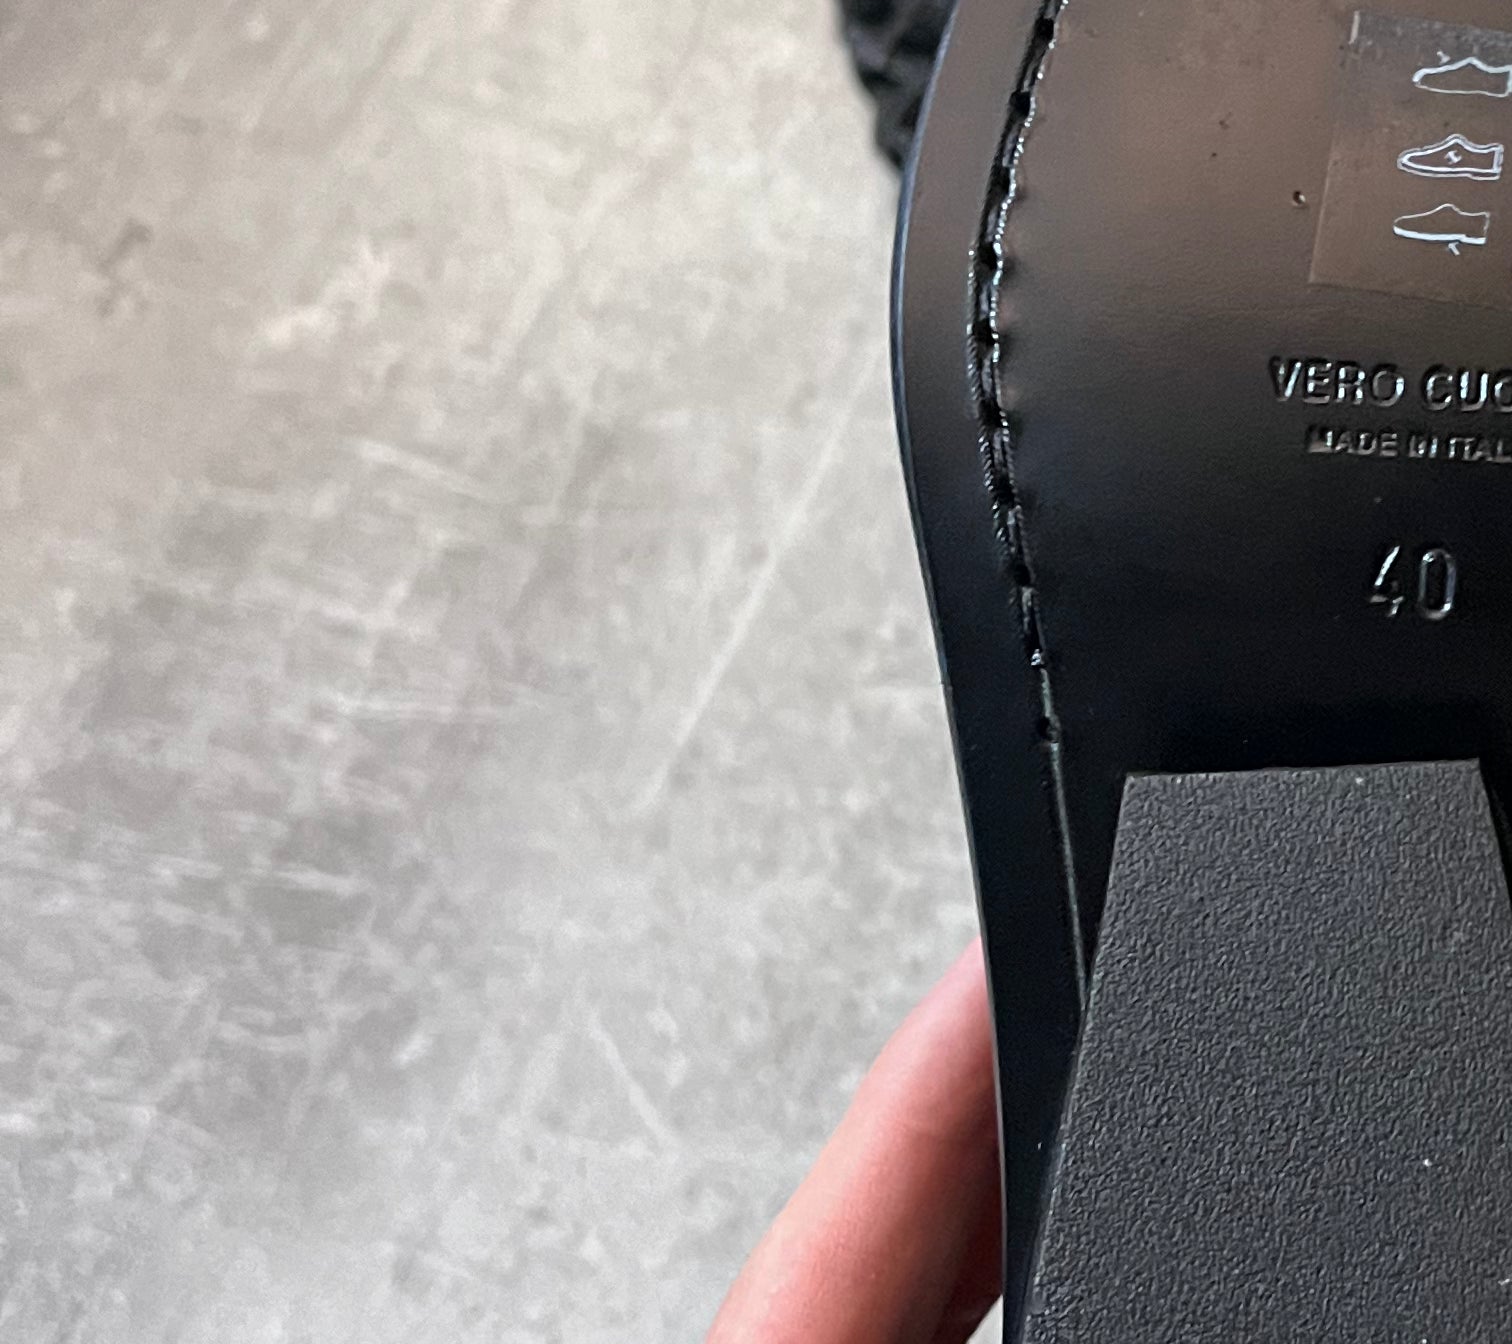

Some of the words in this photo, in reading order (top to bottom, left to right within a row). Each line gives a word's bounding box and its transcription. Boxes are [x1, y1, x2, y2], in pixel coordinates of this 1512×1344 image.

[1268, 356, 1405, 408] VERO
[1304, 426, 1399, 457] MADE
[1408, 433, 1439, 459] IN
[1366, 543, 1458, 620] 40
